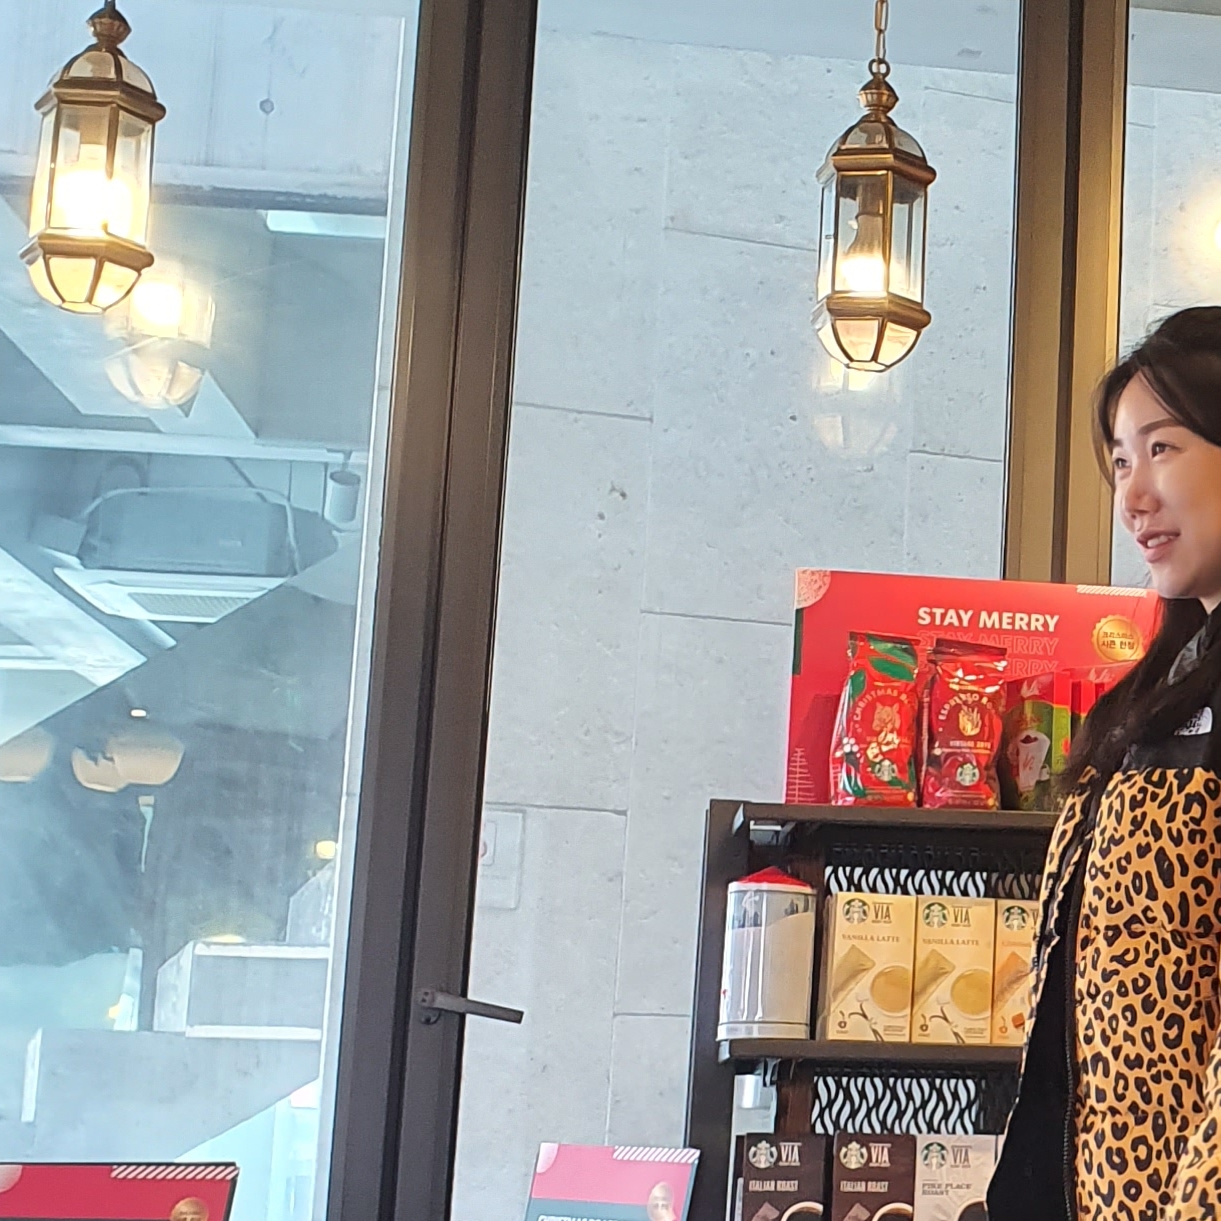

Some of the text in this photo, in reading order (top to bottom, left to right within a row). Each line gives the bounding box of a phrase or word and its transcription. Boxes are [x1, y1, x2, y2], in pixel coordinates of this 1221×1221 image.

[917, 606, 1060, 632] STAY MERRY
[873, 903, 892, 920] VIA
[953, 907, 971, 925] VIA
[780, 1144, 800, 1164] VIA
[870, 1145, 891, 1165] VIA
[951, 1147, 970, 1164] VIA
